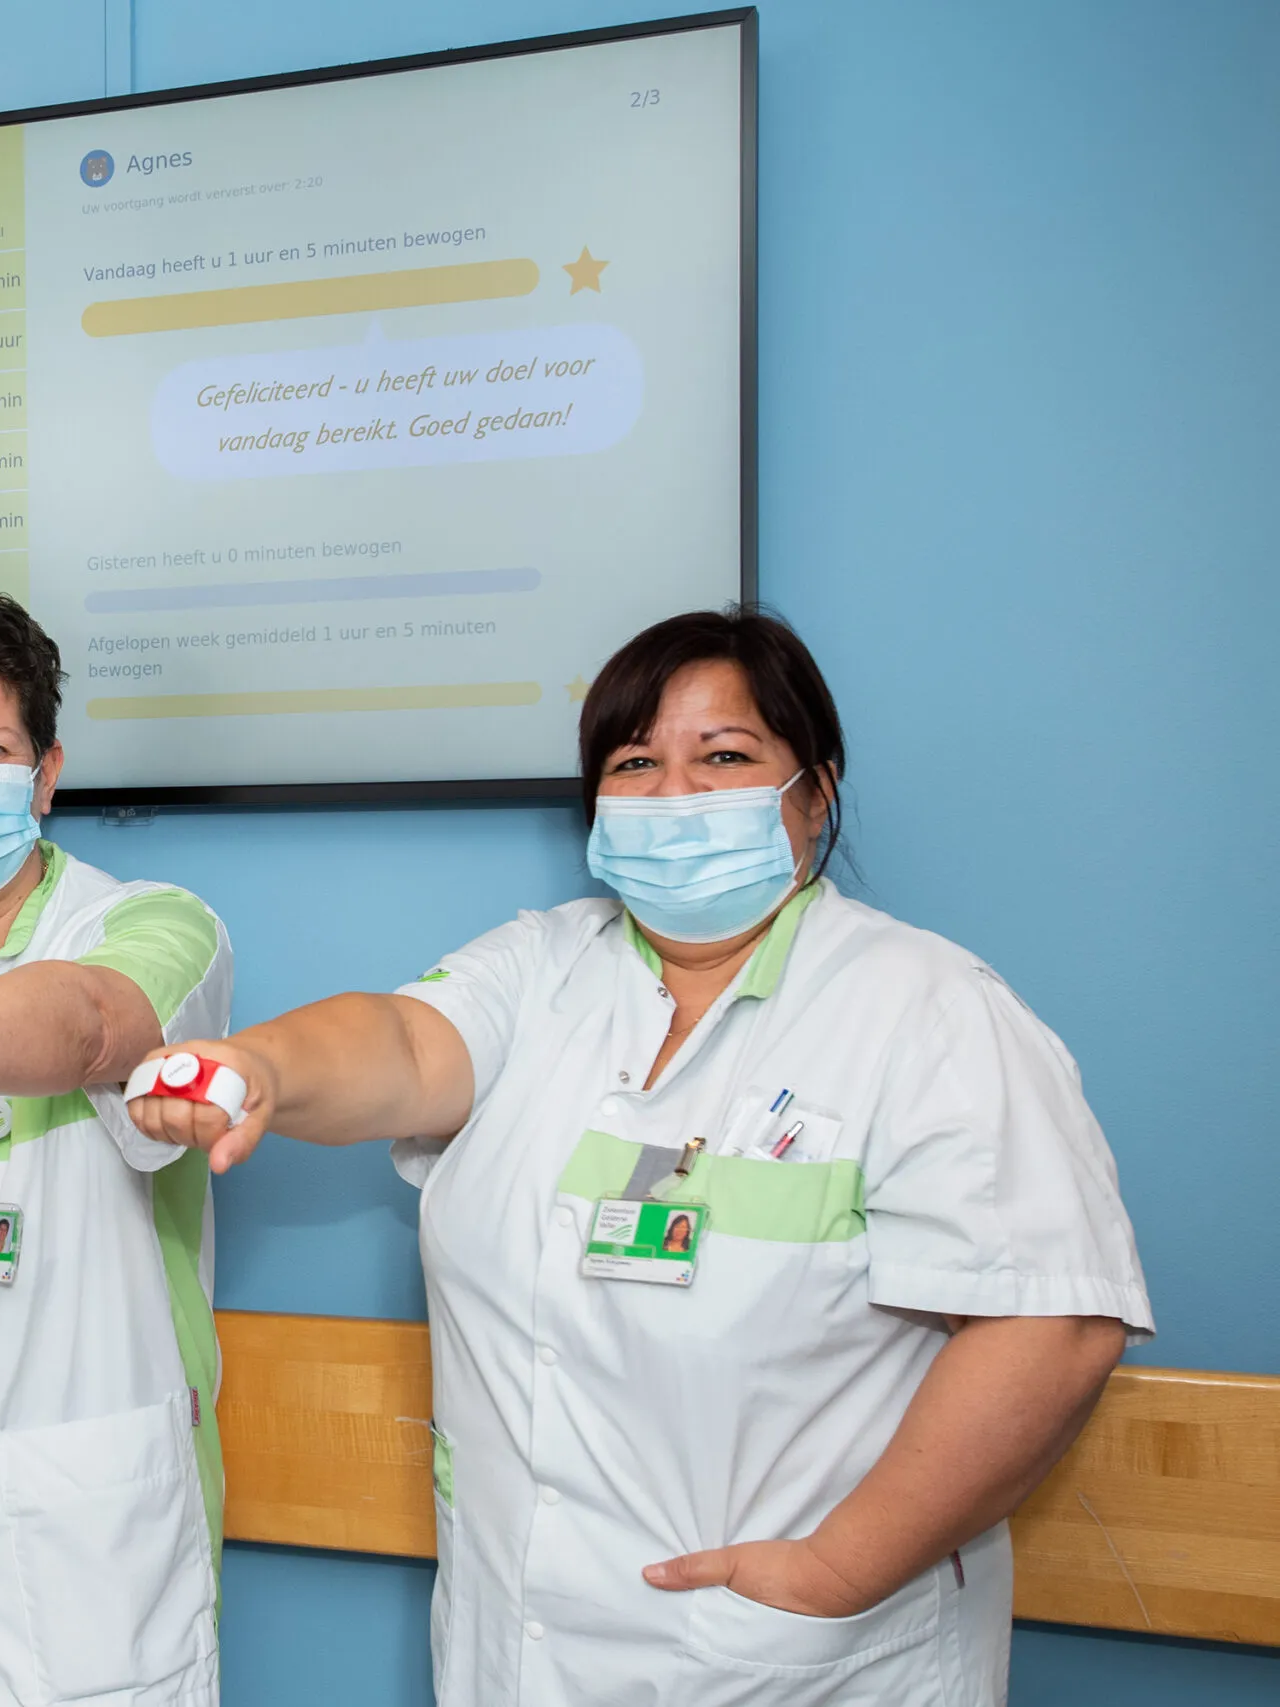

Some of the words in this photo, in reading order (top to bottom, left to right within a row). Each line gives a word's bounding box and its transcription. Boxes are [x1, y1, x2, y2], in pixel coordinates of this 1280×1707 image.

[630, 88, 661, 109] 2/3
[126, 148, 193, 176] Agnes
[83, 260, 156, 283] Vandaag
[161, 254, 206, 275] heeft
[210, 256, 222, 268] u
[228, 250, 237, 267] 1
[243, 247, 274, 266] uur
[278, 245, 301, 260] en
[306, 242, 317, 258] 5
[322, 234, 397, 258] minuten
[402, 224, 487, 252] bewogen
[196, 374, 334, 412] Gefeliciteerd
[354, 376, 371, 395] u
[376, 365, 439, 393] heeft
[444, 365, 480, 387] uw
[485, 356, 538, 384] doel
[543, 356, 596, 379] voor
[218, 426, 309, 455] vandaag
[316, 418, 398, 447] bereikt.
[407, 412, 470, 440] Goed
[473, 403, 572, 437] gedaan!
[86, 551, 157, 572] Gisteren
[162, 548, 206, 568] heeft
[211, 553, 222, 565] u
[227, 548, 239, 564] 0
[244, 543, 316, 562] minuten
[322, 538, 403, 562] bewogen
[87, 633, 171, 656] Afgelopen
[176, 630, 221, 648] week
[225, 625, 317, 651] gemiddeld
[323, 625, 333, 642] 1
[339, 626, 370, 642] uur
[375, 624, 398, 640] en
[404, 623, 415, 639] 5
[420, 618, 497, 638] minuten
[87, 660, 163, 683] bewogen
